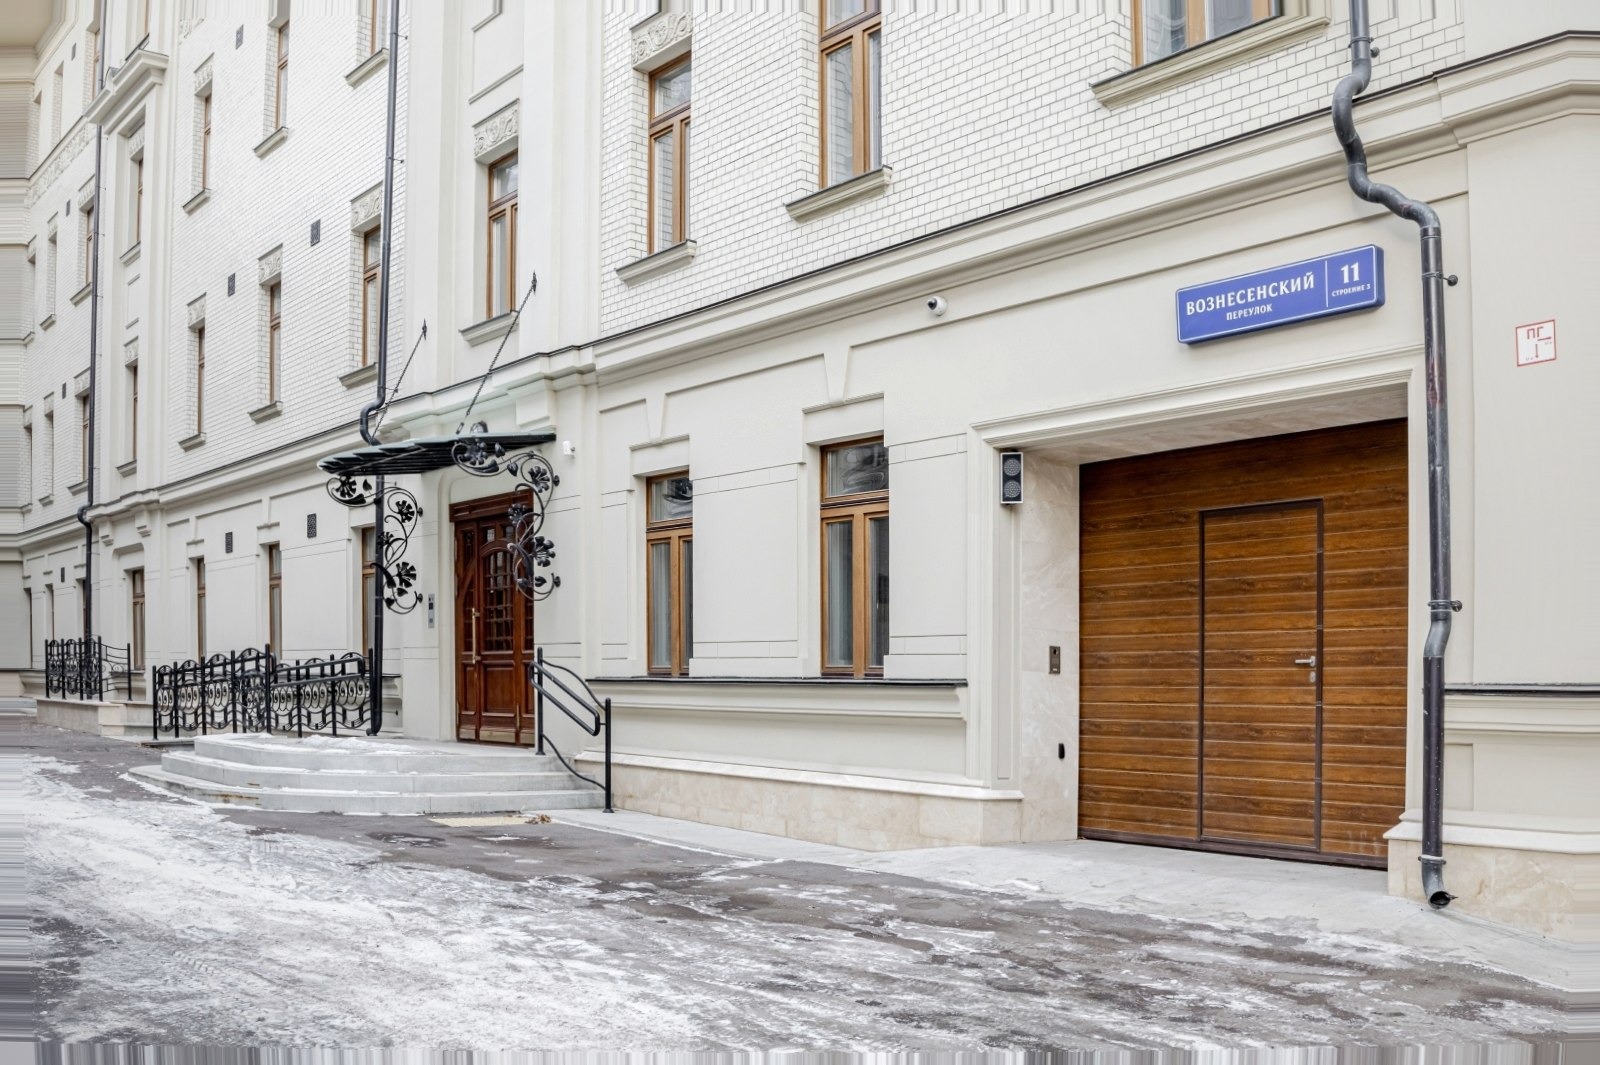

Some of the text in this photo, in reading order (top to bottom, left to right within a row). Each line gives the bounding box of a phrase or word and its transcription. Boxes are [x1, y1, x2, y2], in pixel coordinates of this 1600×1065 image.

[1340, 262, 1360, 284] 11
[1186, 271, 1315, 316] ВОЗНЕСЕНСКИЙ
[1331, 285, 1365, 297] СТРОЕНИЕ
[1226, 303, 1273, 321] ПЕРЕУЛОК
